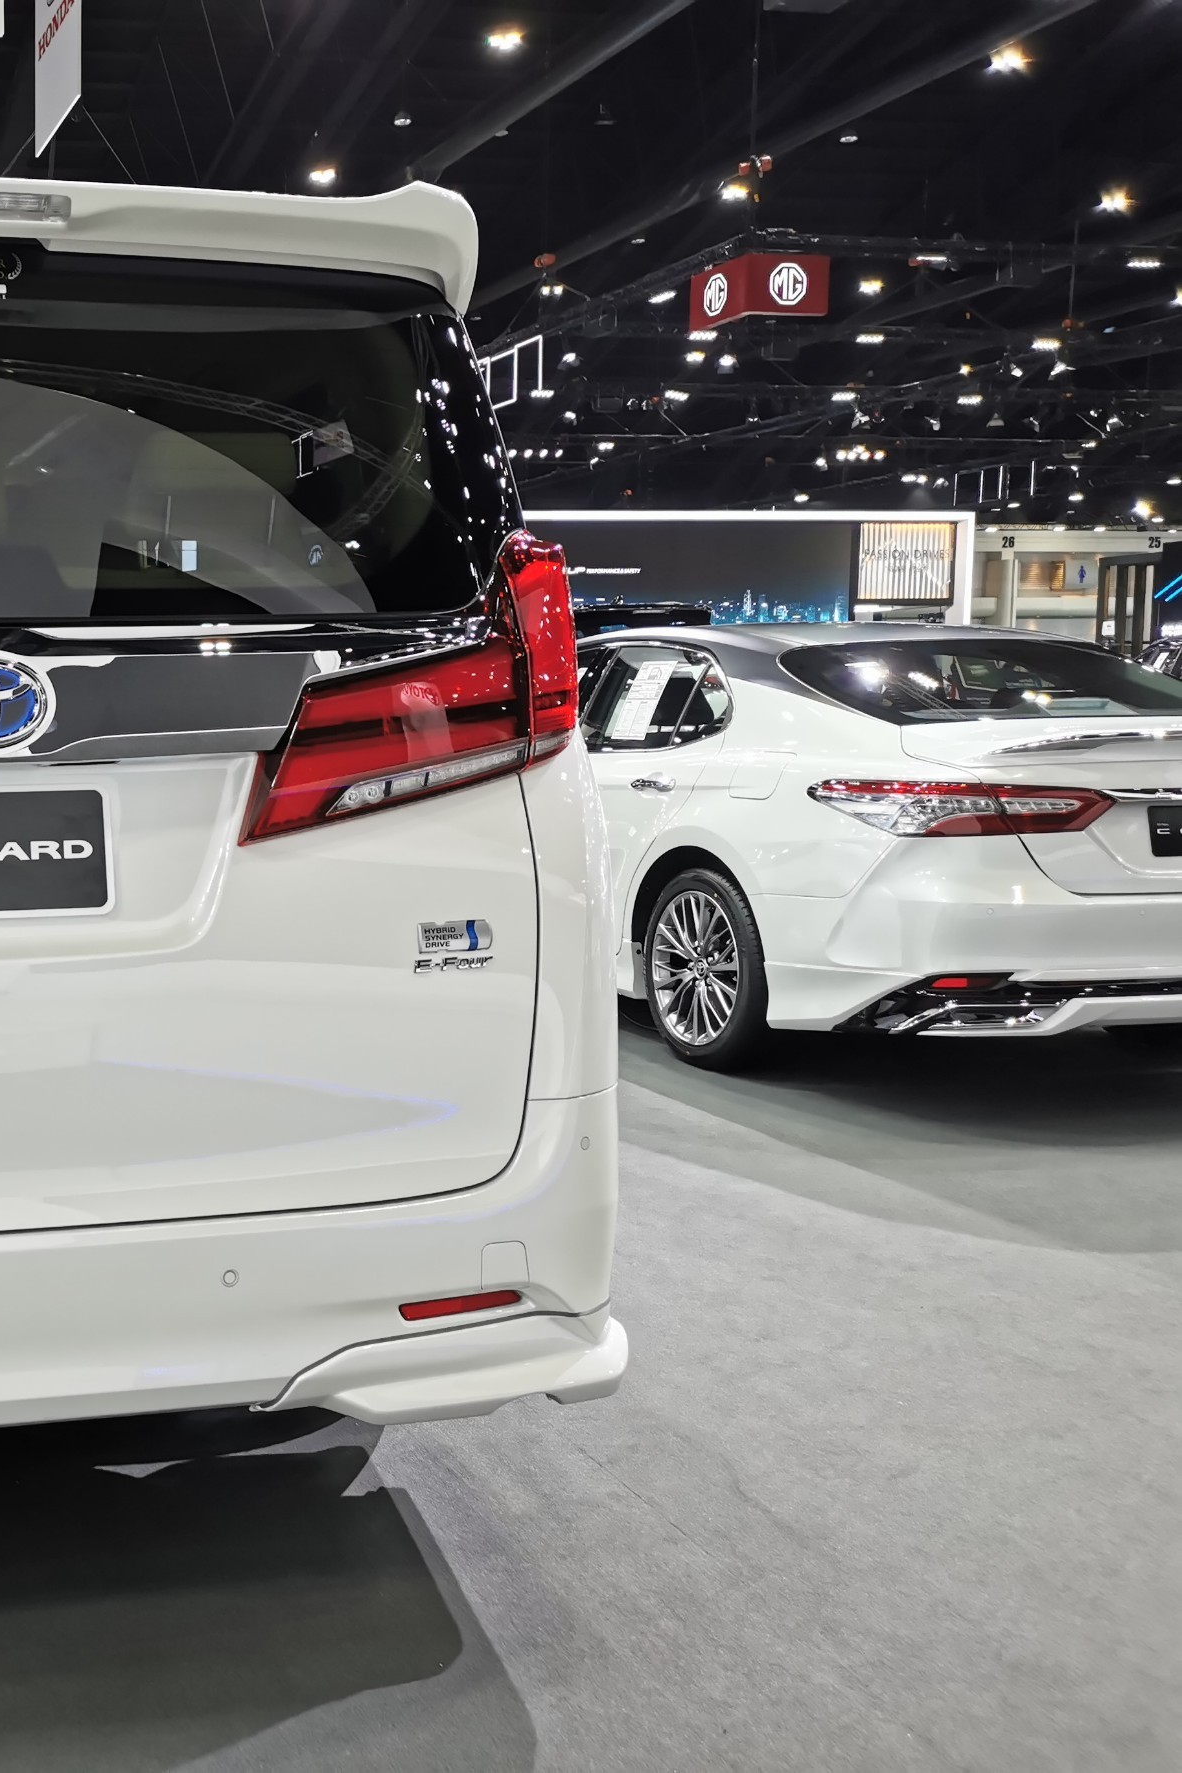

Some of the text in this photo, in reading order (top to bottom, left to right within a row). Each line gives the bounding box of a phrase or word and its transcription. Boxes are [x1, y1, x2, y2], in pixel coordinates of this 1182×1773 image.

[771, 265, 806, 303] MG
[705, 276, 727, 315] MG
[1001, 536, 1015, 549] 26
[1148, 536, 1162, 549] 25
[423, 926, 456, 935] HYBRID
[424, 932, 464, 942] SYNERGY
[425, 940, 451, 949] DRIVE
[414, 955, 494, 974] E-Four
